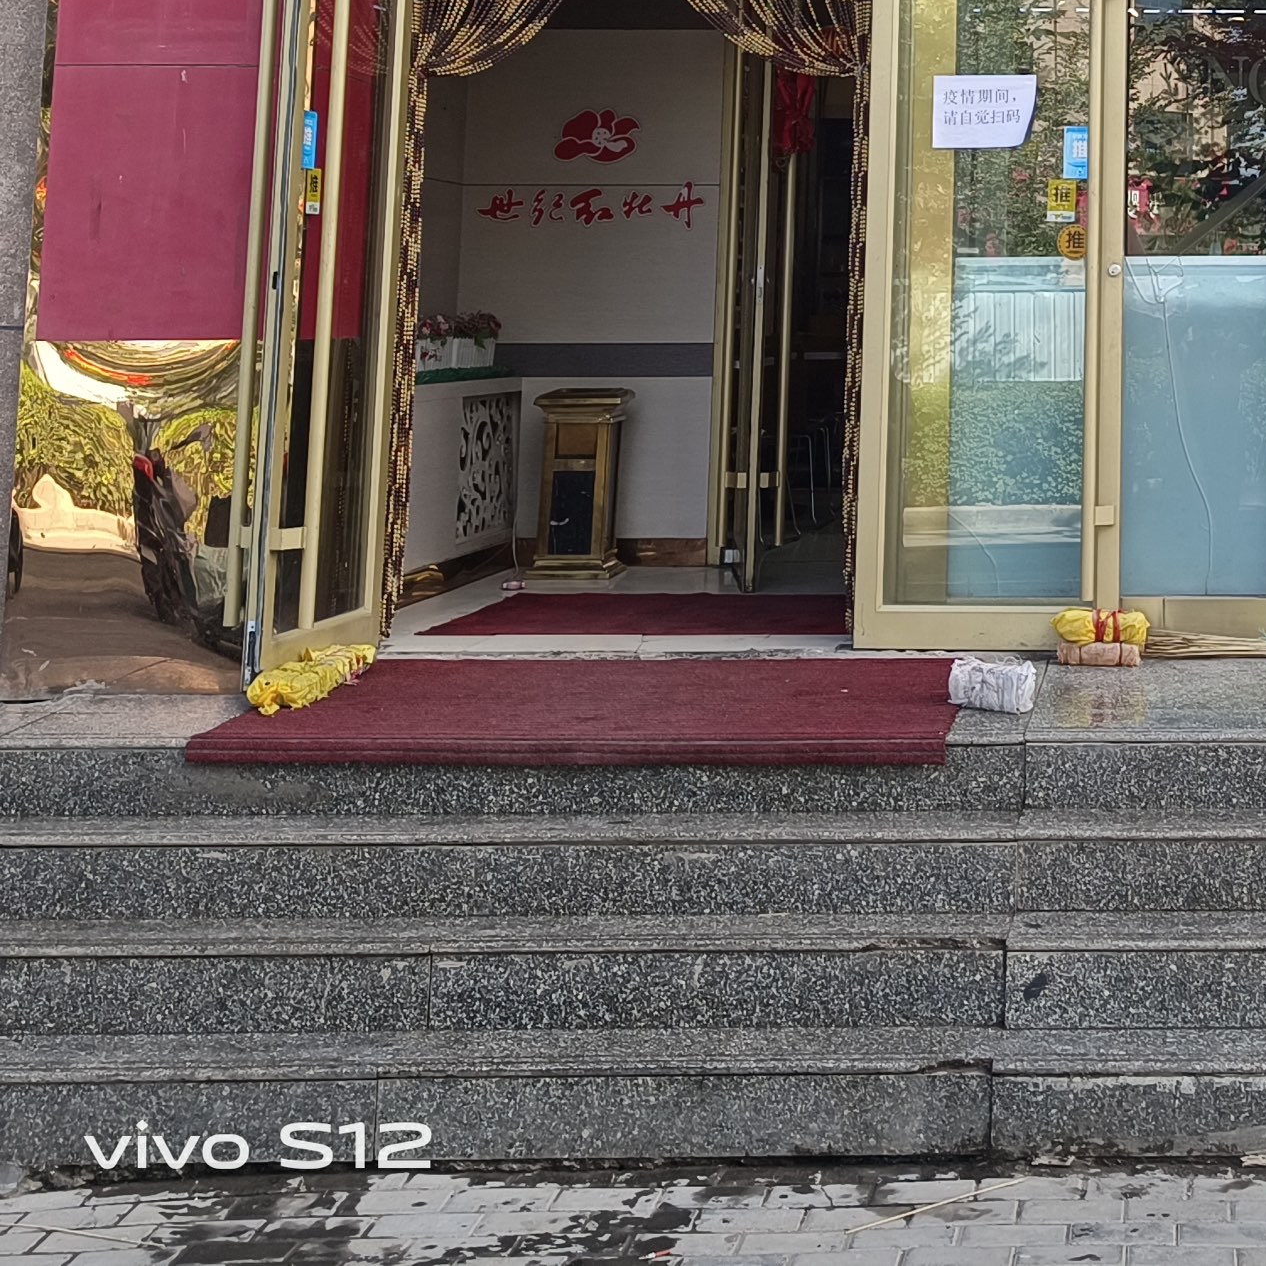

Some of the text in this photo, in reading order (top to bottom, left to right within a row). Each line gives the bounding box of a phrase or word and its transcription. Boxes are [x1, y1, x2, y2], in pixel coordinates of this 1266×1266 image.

[943, 109, 1021, 126] 请自觉扫码
[1052, 185, 1071, 203] 推
[476, 181, 705, 230] 世纪红牡丹
[1065, 230, 1085, 250] 推
